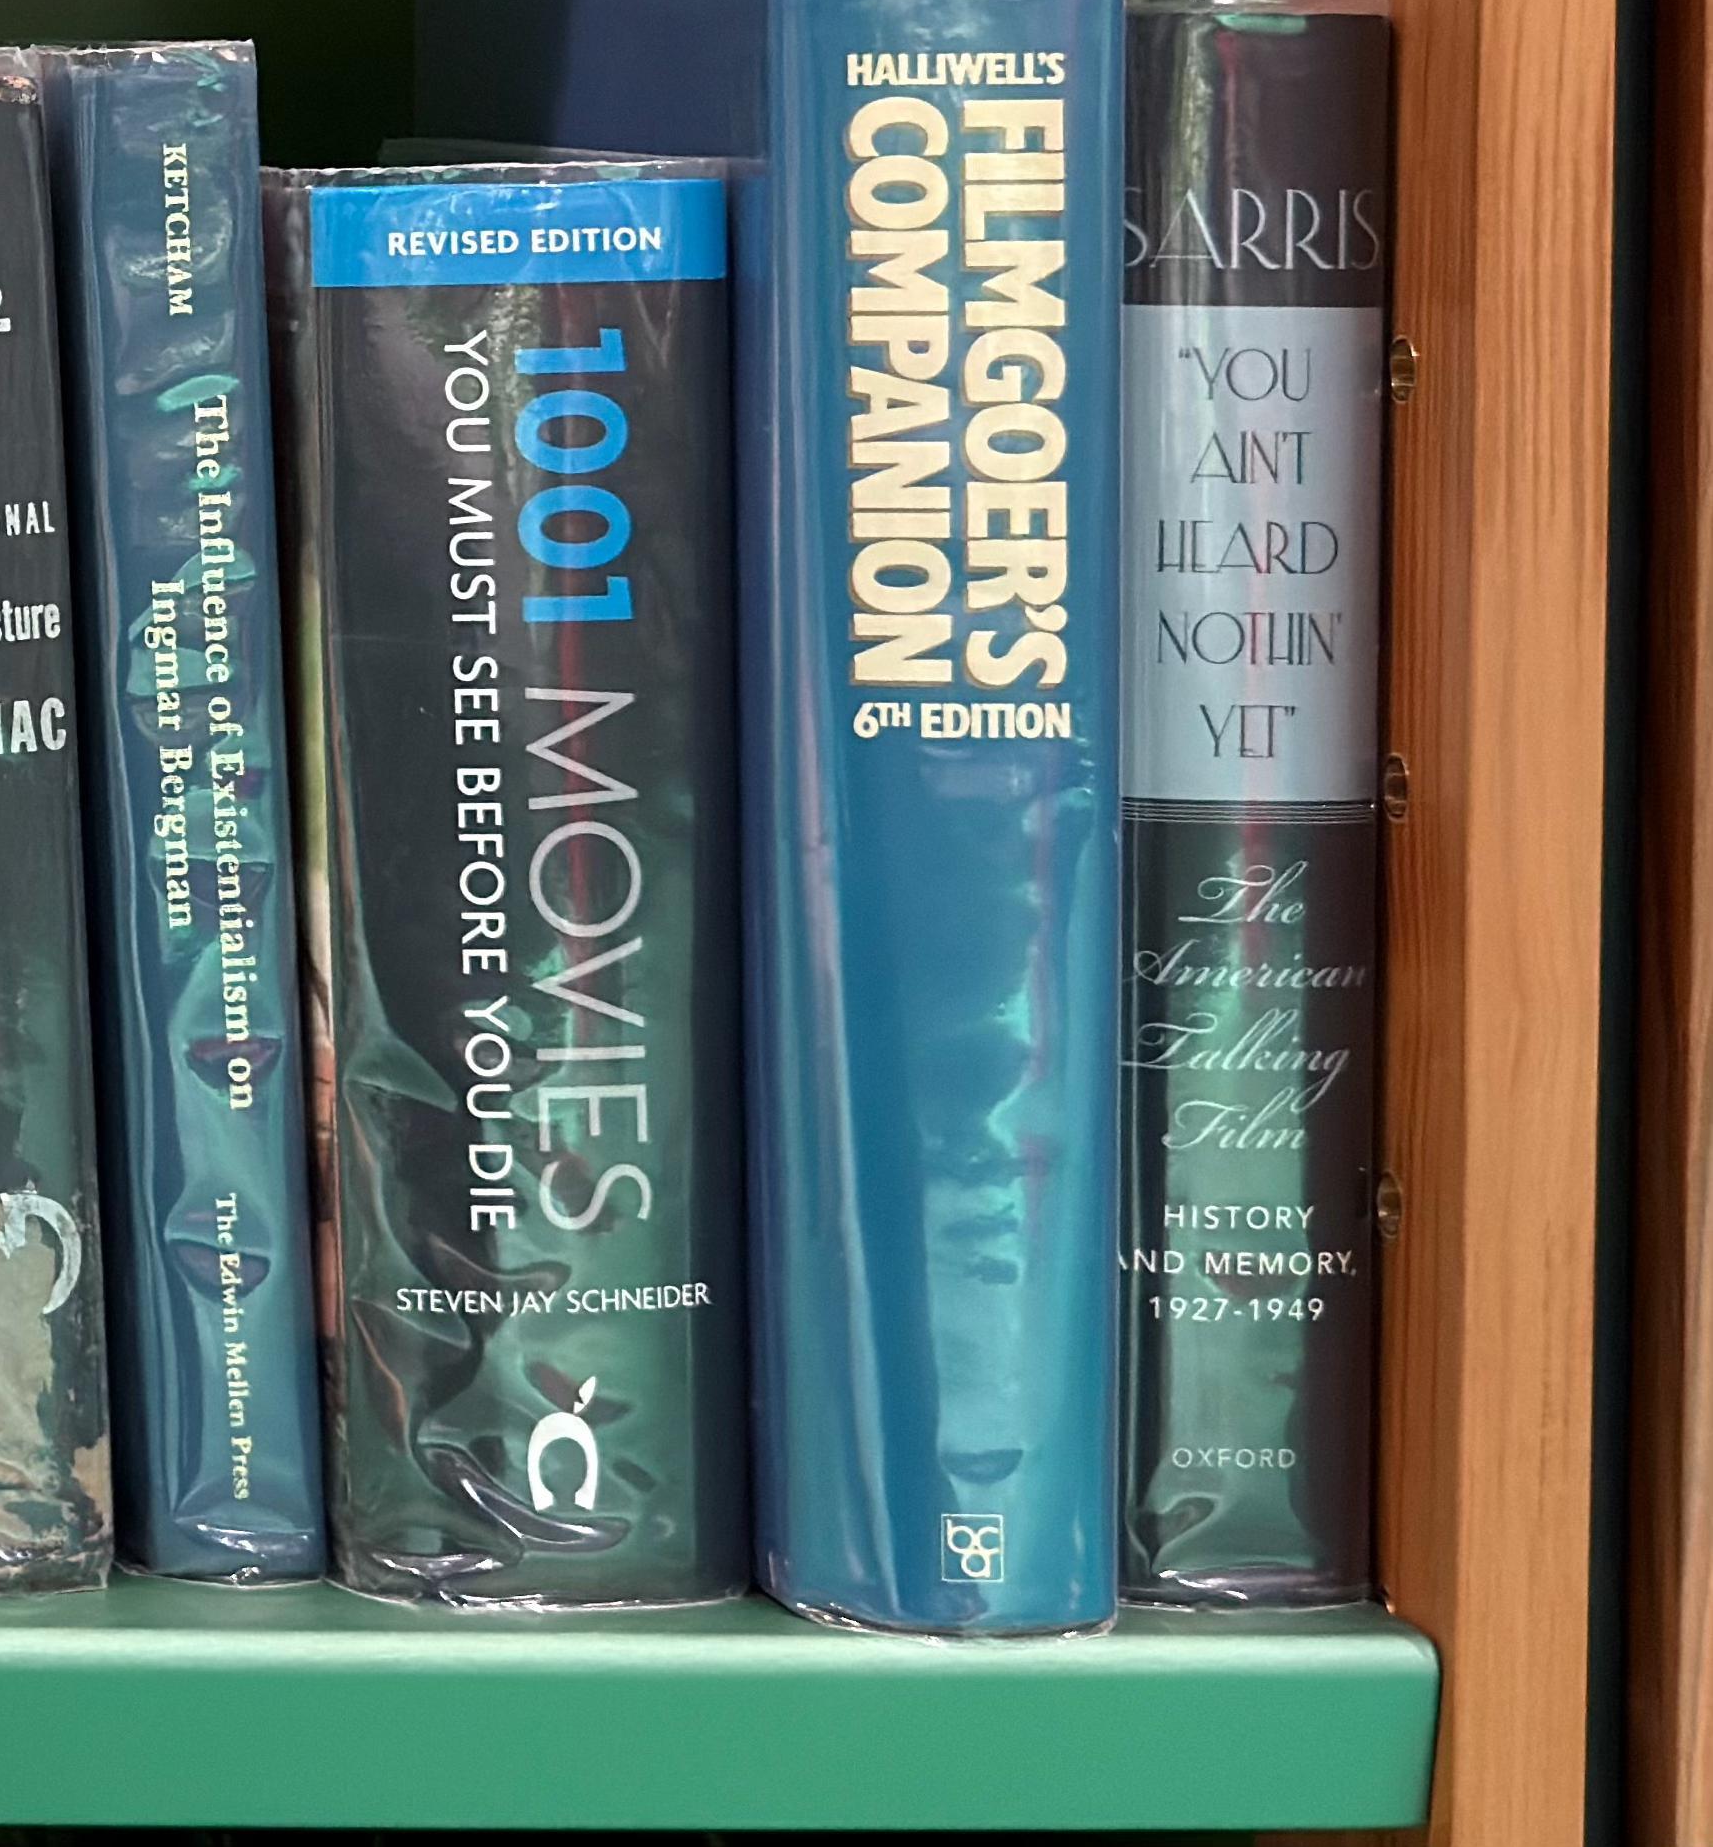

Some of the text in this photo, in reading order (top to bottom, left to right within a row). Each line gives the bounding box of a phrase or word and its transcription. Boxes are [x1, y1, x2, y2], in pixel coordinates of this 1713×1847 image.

[847, 53, 1066, 86] HALLIWELL'S
[161, 142, 193, 316] KETCHAM
[388, 227, 662, 256] REVISED EDITION
[1124, 187, 1379, 270] SARRIS
[846, 96, 952, 689] COMPANION
[961, 98, 1069, 690] FILMGOER'S
[1157, 520, 1338, 575] HEARD
[144, 579, 193, 929] Ingmar Bergman
[193, 394, 257, 1109] The Influence Existentialism on
[921, 703, 1071, 738] EDITION
[444, 330, 517, 1231] YOU MUST SEE BEFORE YOU DIE
[514, 328, 651, 1229] 1001 MOVIES
[1179, 860, 1309, 924] The
[1163, 1204, 1315, 1230] HISTORY
[396, 1282, 714, 1318] STEVEN JAY SCHNEIDER
[1149, 1297, 1325, 1322] 1927-1949
[215, 1193, 253, 1499] The Edwin Press
[1173, 1448, 1297, 1469] OXFORD
